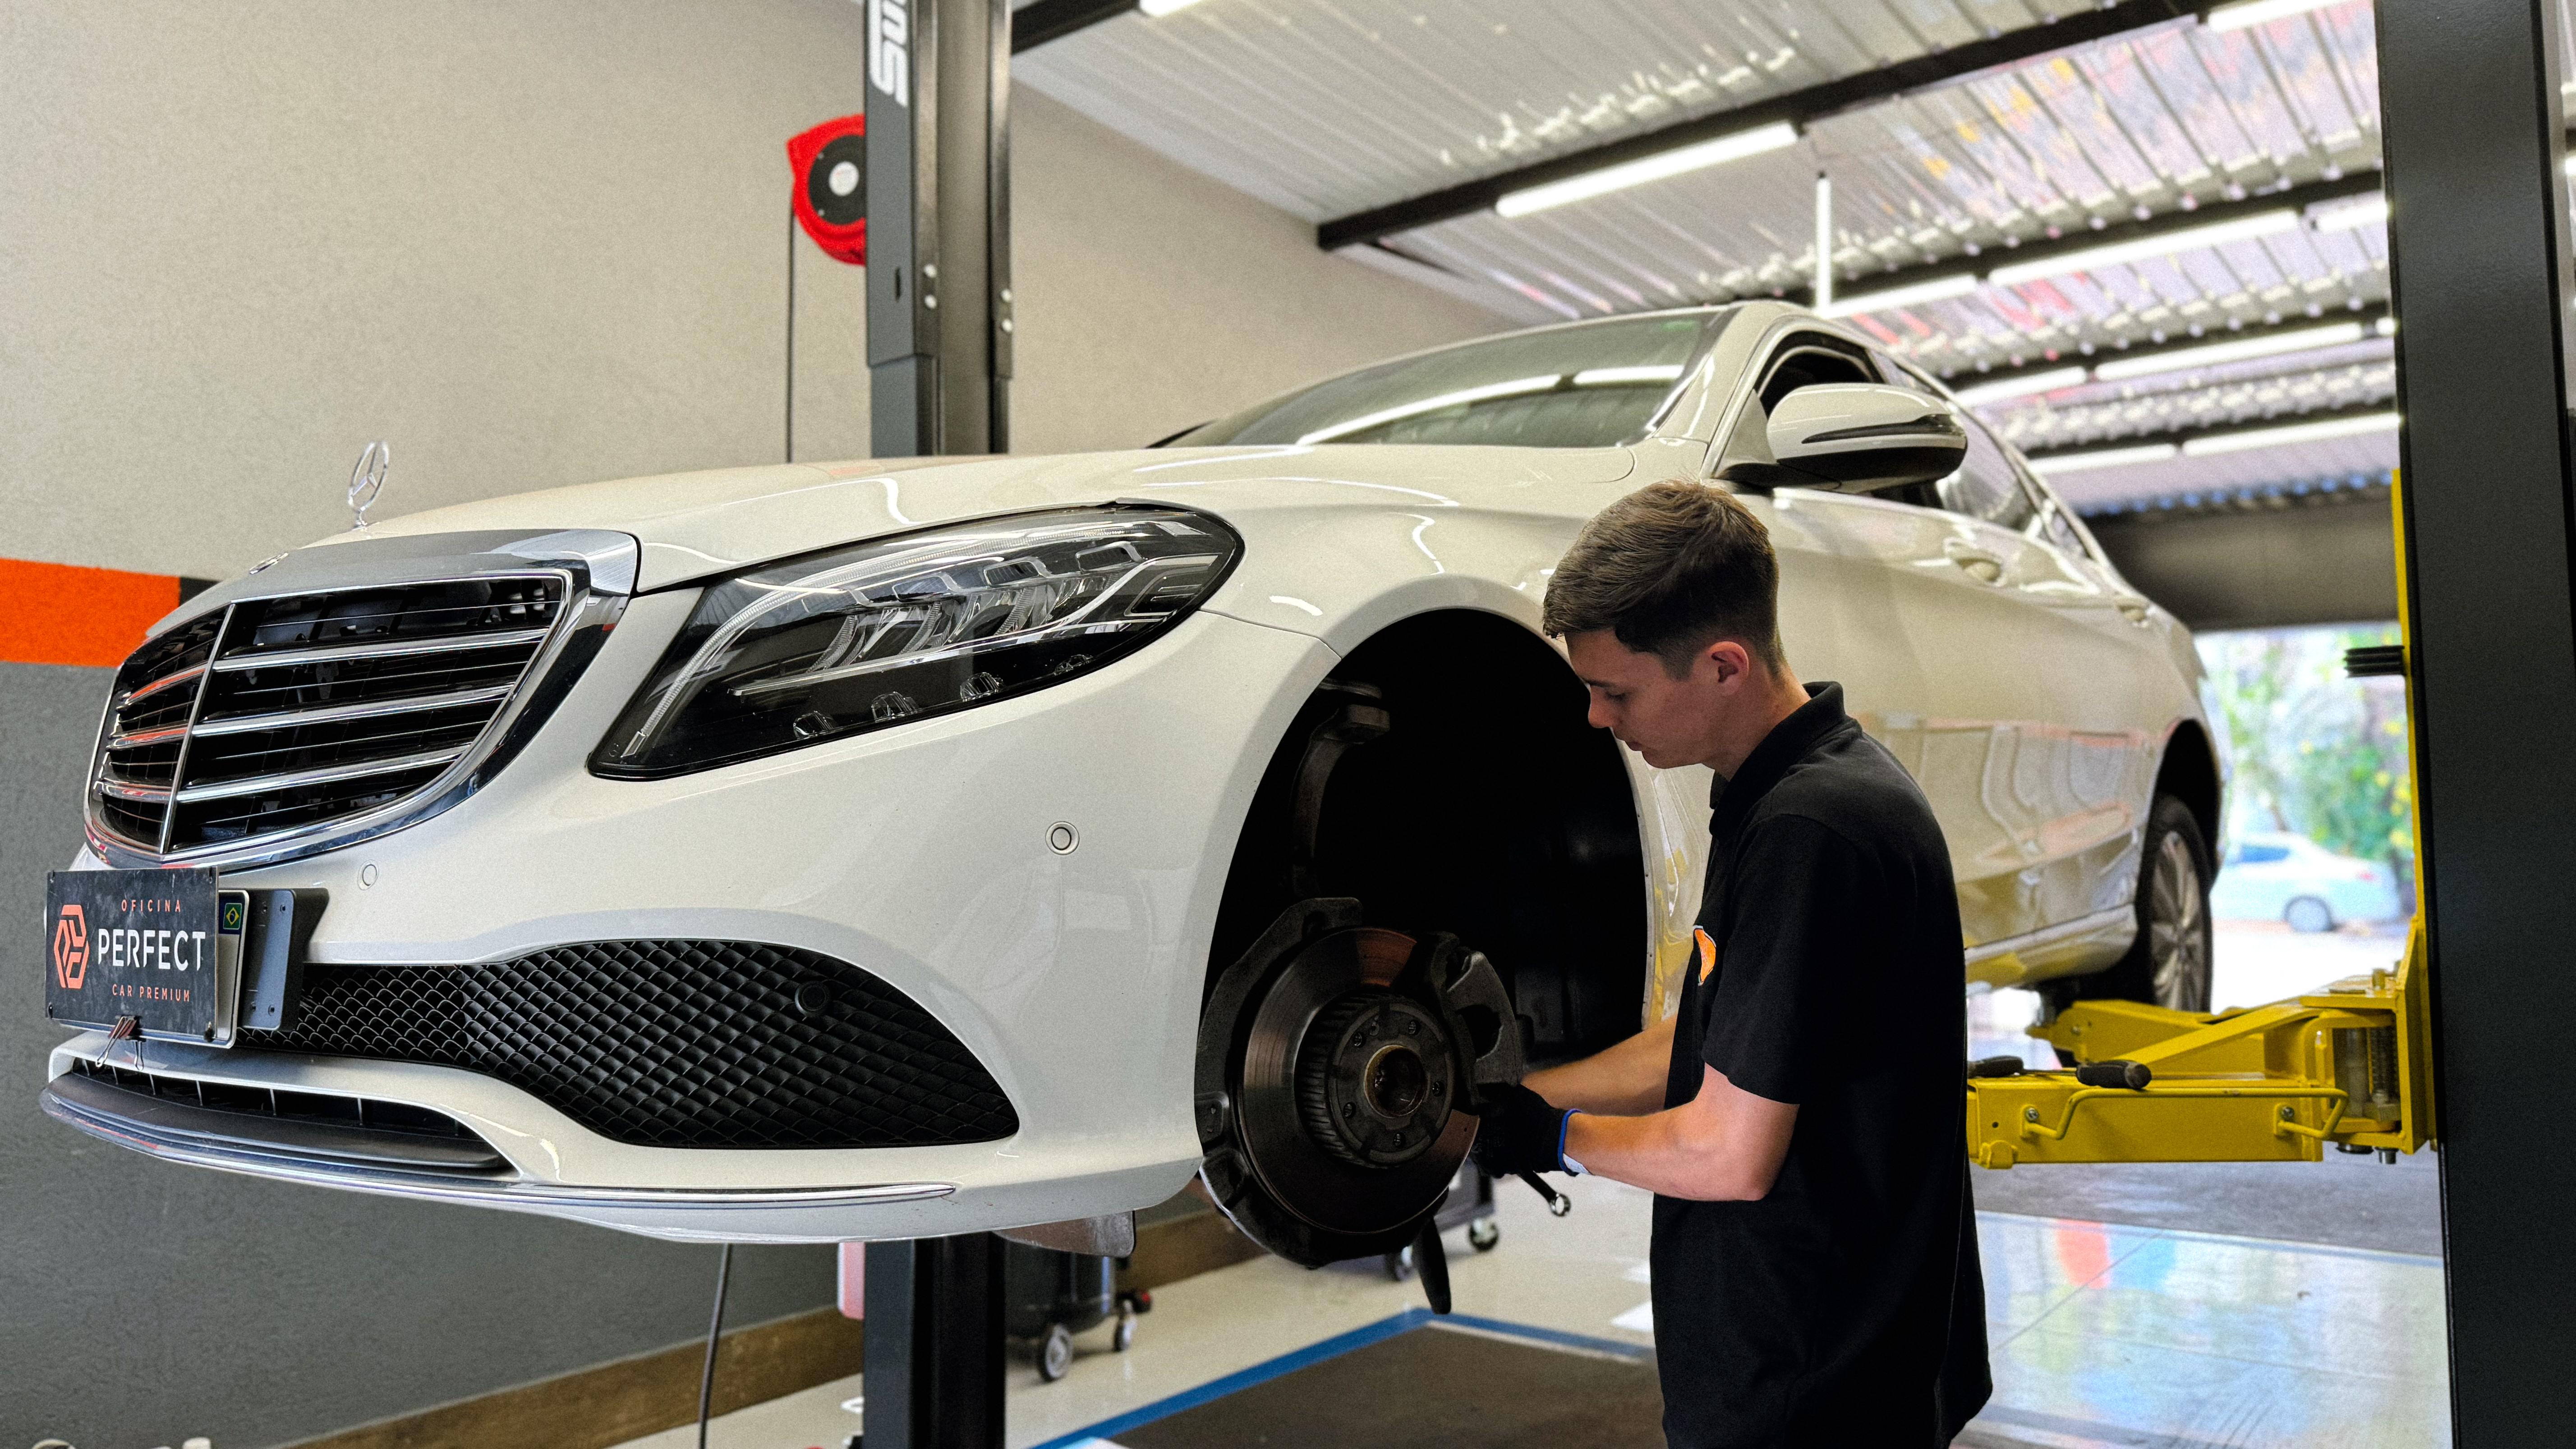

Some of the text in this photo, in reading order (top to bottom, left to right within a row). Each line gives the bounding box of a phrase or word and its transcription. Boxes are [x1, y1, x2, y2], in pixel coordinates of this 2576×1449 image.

[121, 899, 181, 913] OFICINA
[98, 929, 206, 971] PERFECT
[112, 984, 190, 1002] CAR PREMIUM
